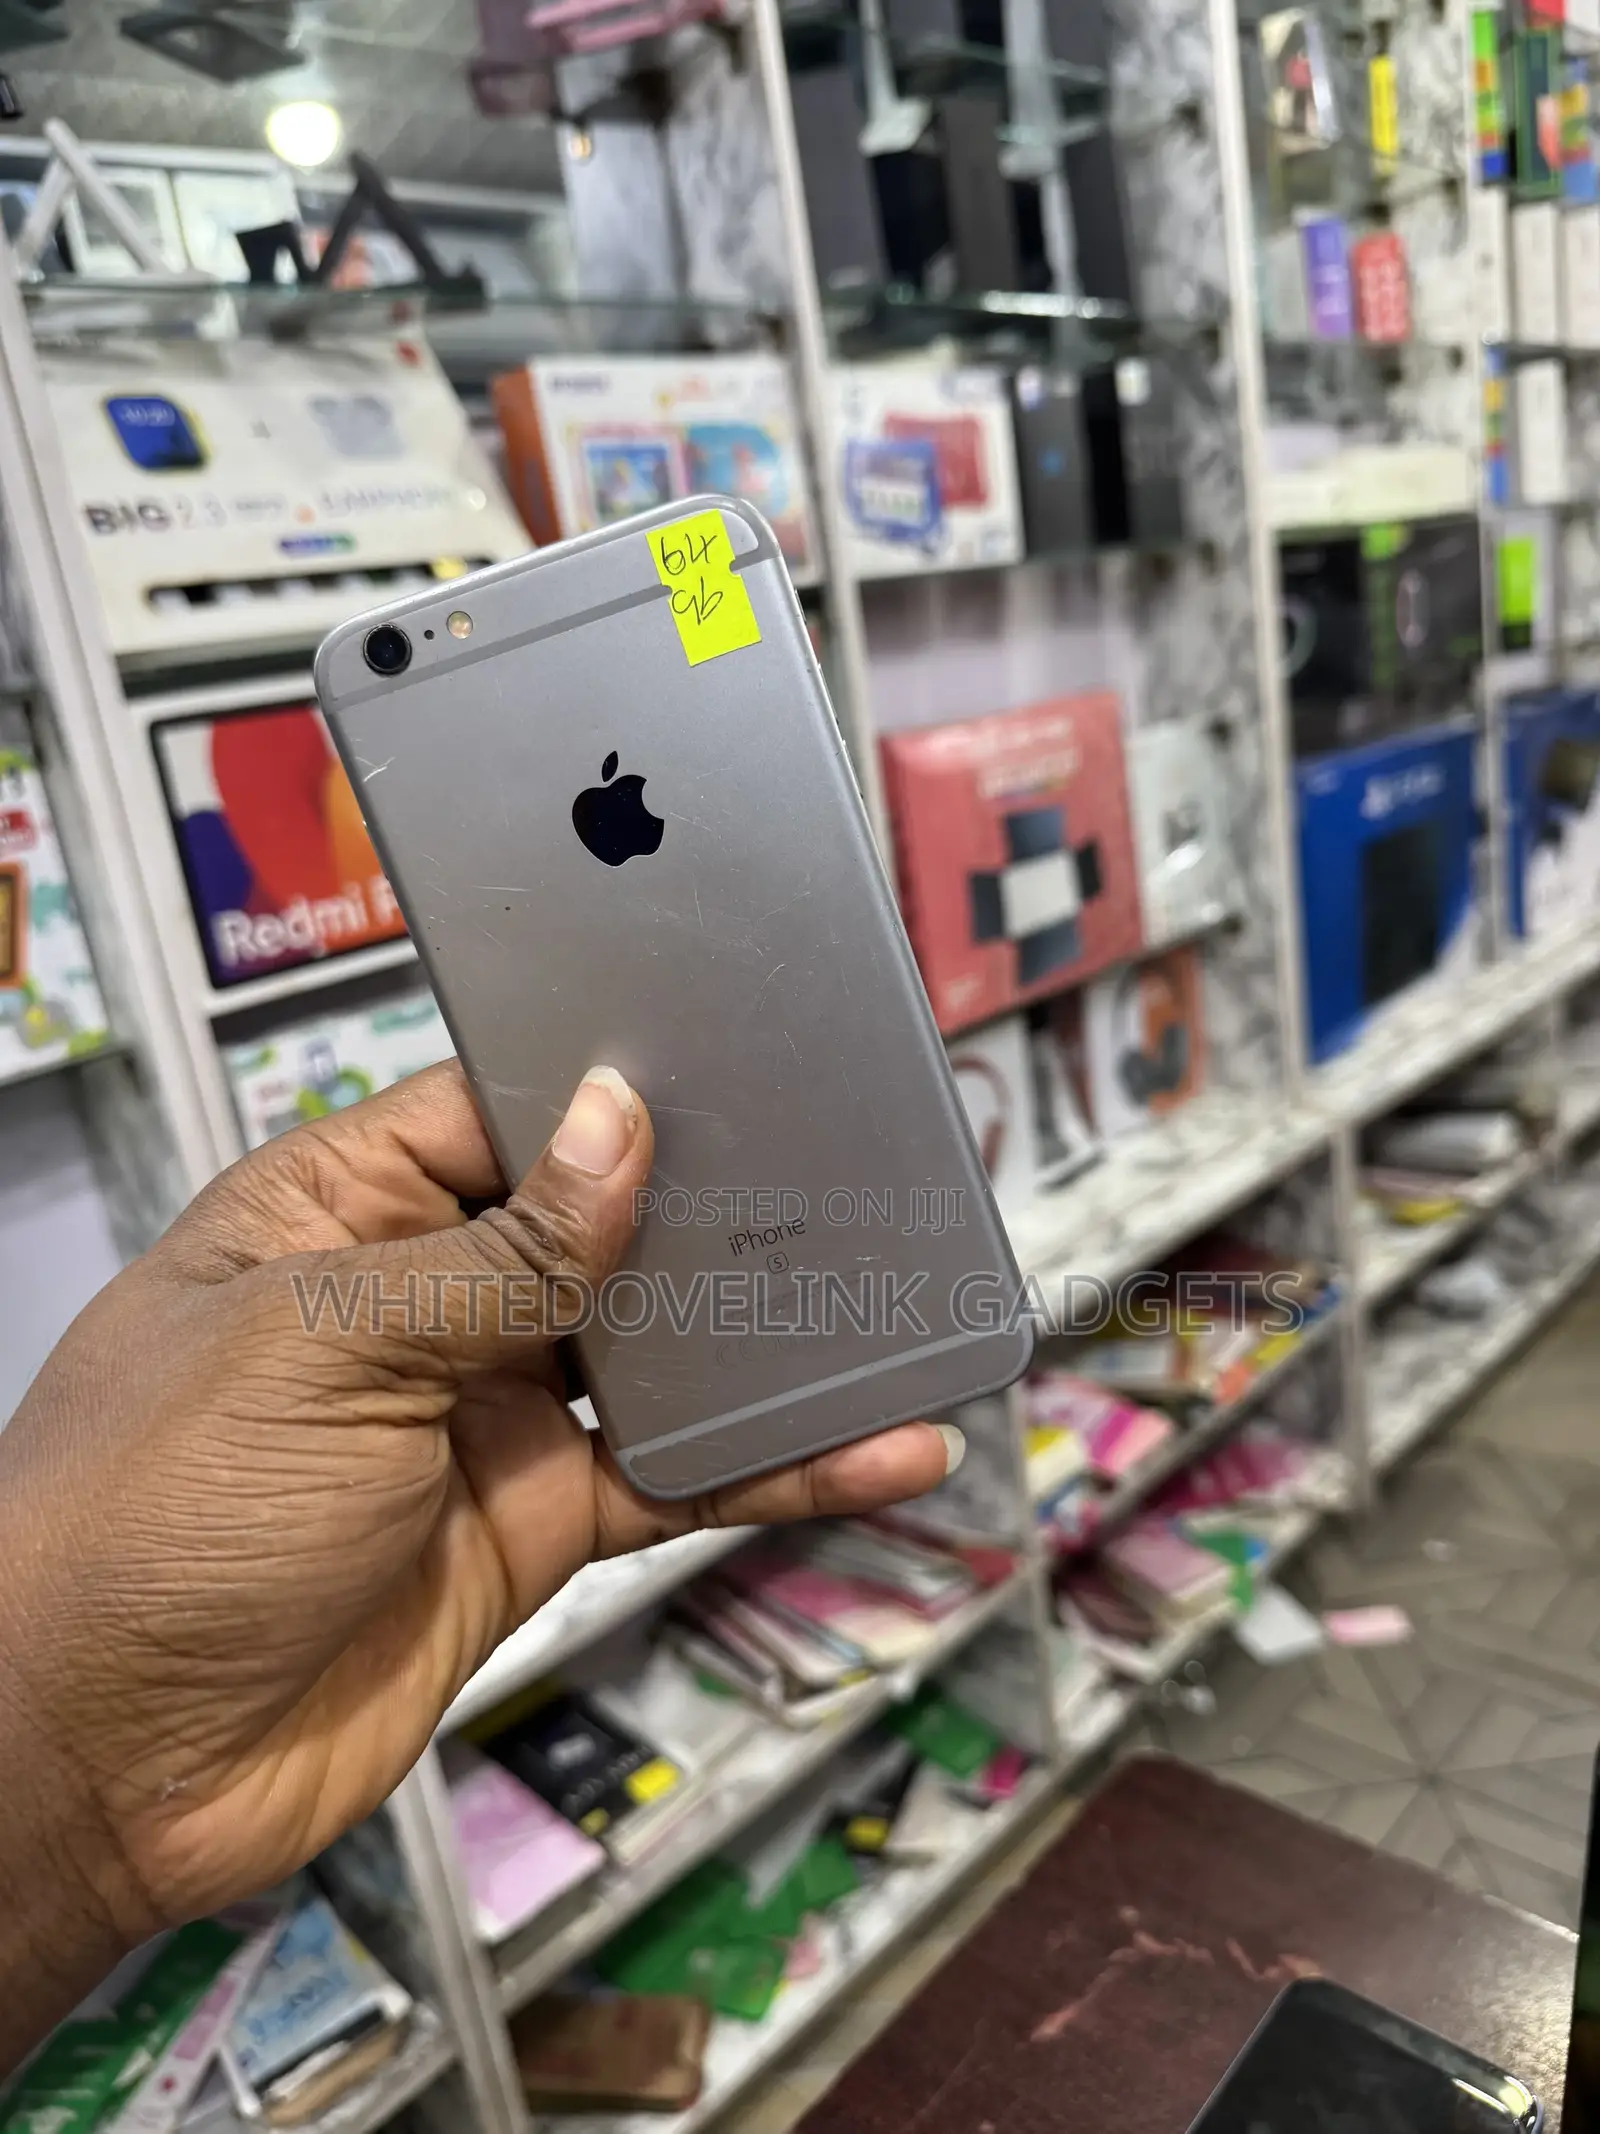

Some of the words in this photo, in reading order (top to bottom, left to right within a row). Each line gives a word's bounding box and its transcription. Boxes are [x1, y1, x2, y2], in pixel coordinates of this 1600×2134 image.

[661, 533, 718, 576] 64
[211, 880, 369, 966] Redmi
[728, 1219, 806, 1257] iPhone
